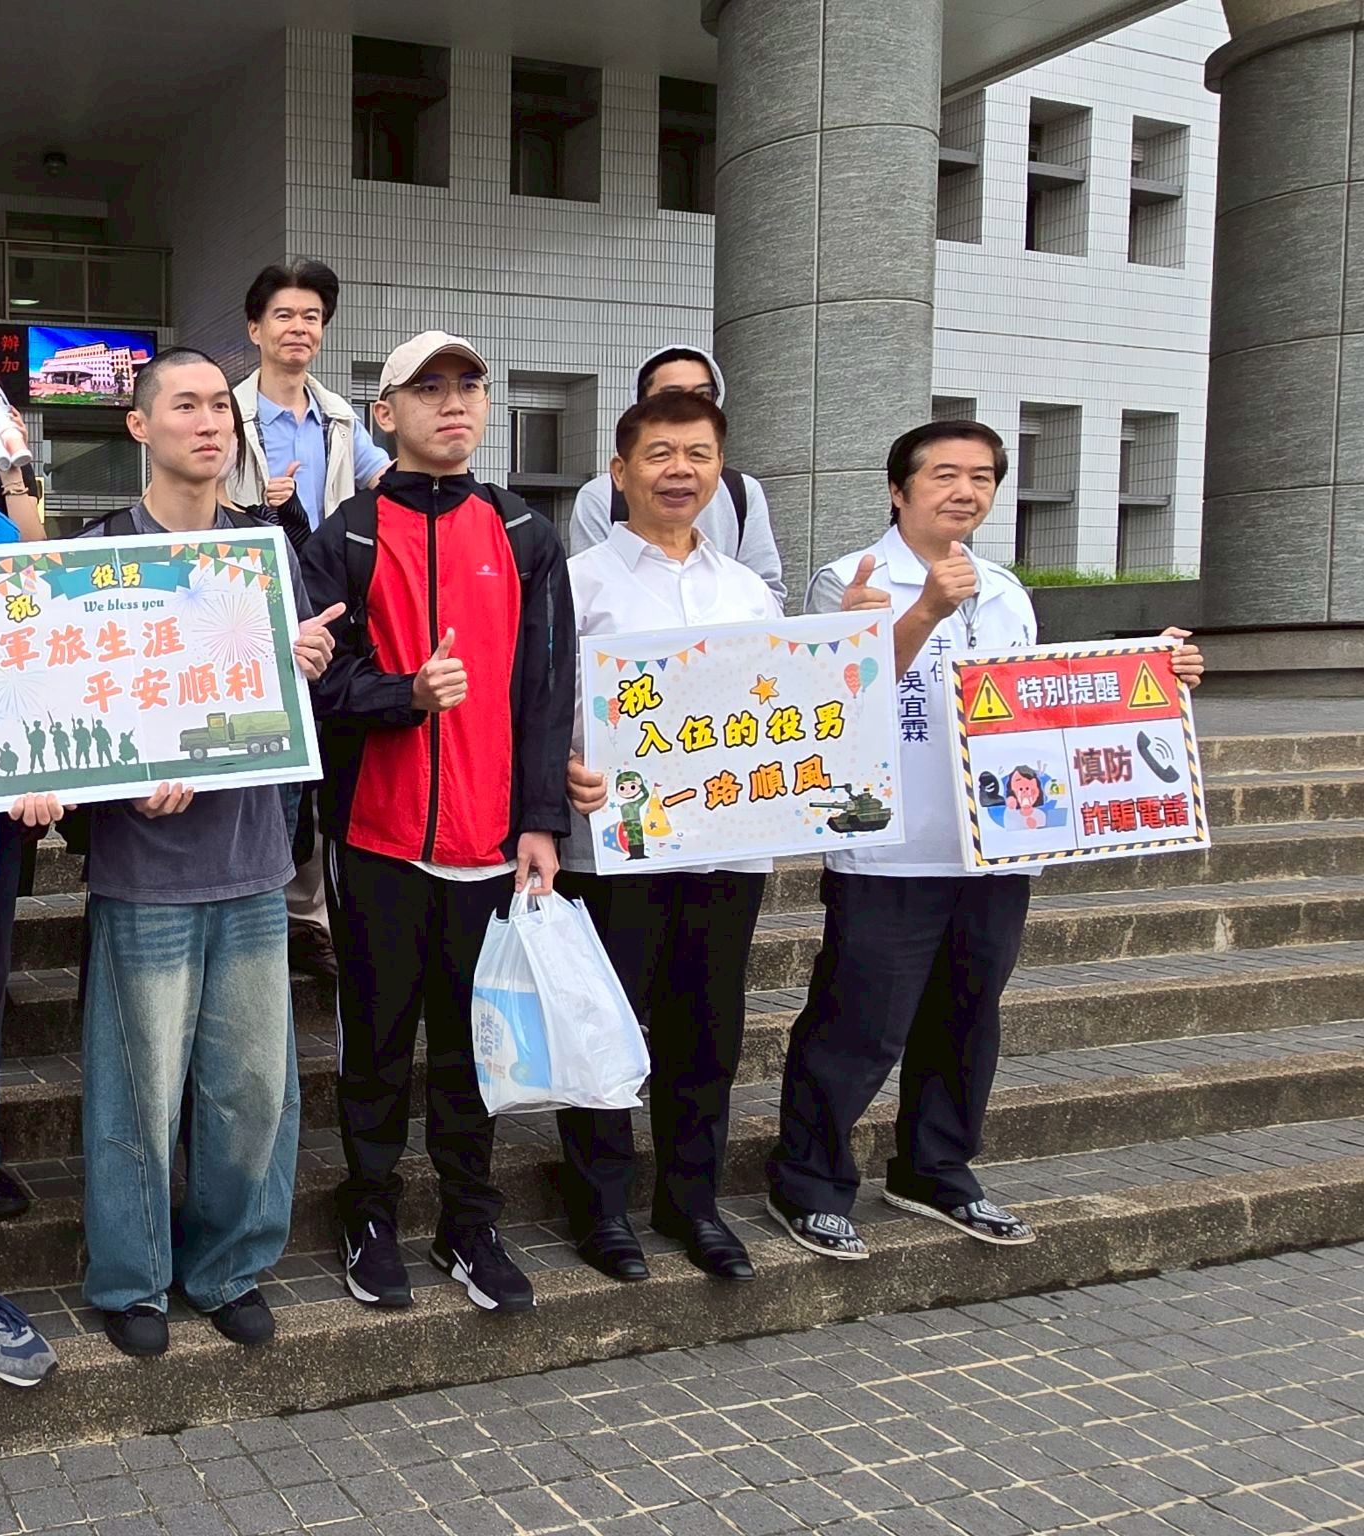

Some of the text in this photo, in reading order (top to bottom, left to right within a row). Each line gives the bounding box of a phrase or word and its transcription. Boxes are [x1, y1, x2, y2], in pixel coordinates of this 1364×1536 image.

[91, 562, 143, 588] 役男
[5, 593, 41, 623] 祝
[84, 598, 164, 612] We bless you
[82, 659, 265, 713] 平安順利
[618, 674, 662, 718] 祝
[899, 670, 929, 742] 吳宜霖
[1017, 671, 1121, 709] 特別提醒
[635, 702, 845, 757] 入伍的役男
[663, 754, 833, 810] 一路順風
[1074, 745, 1133, 786] 慎防
[1081, 793, 1189, 837] 詐騙電話
